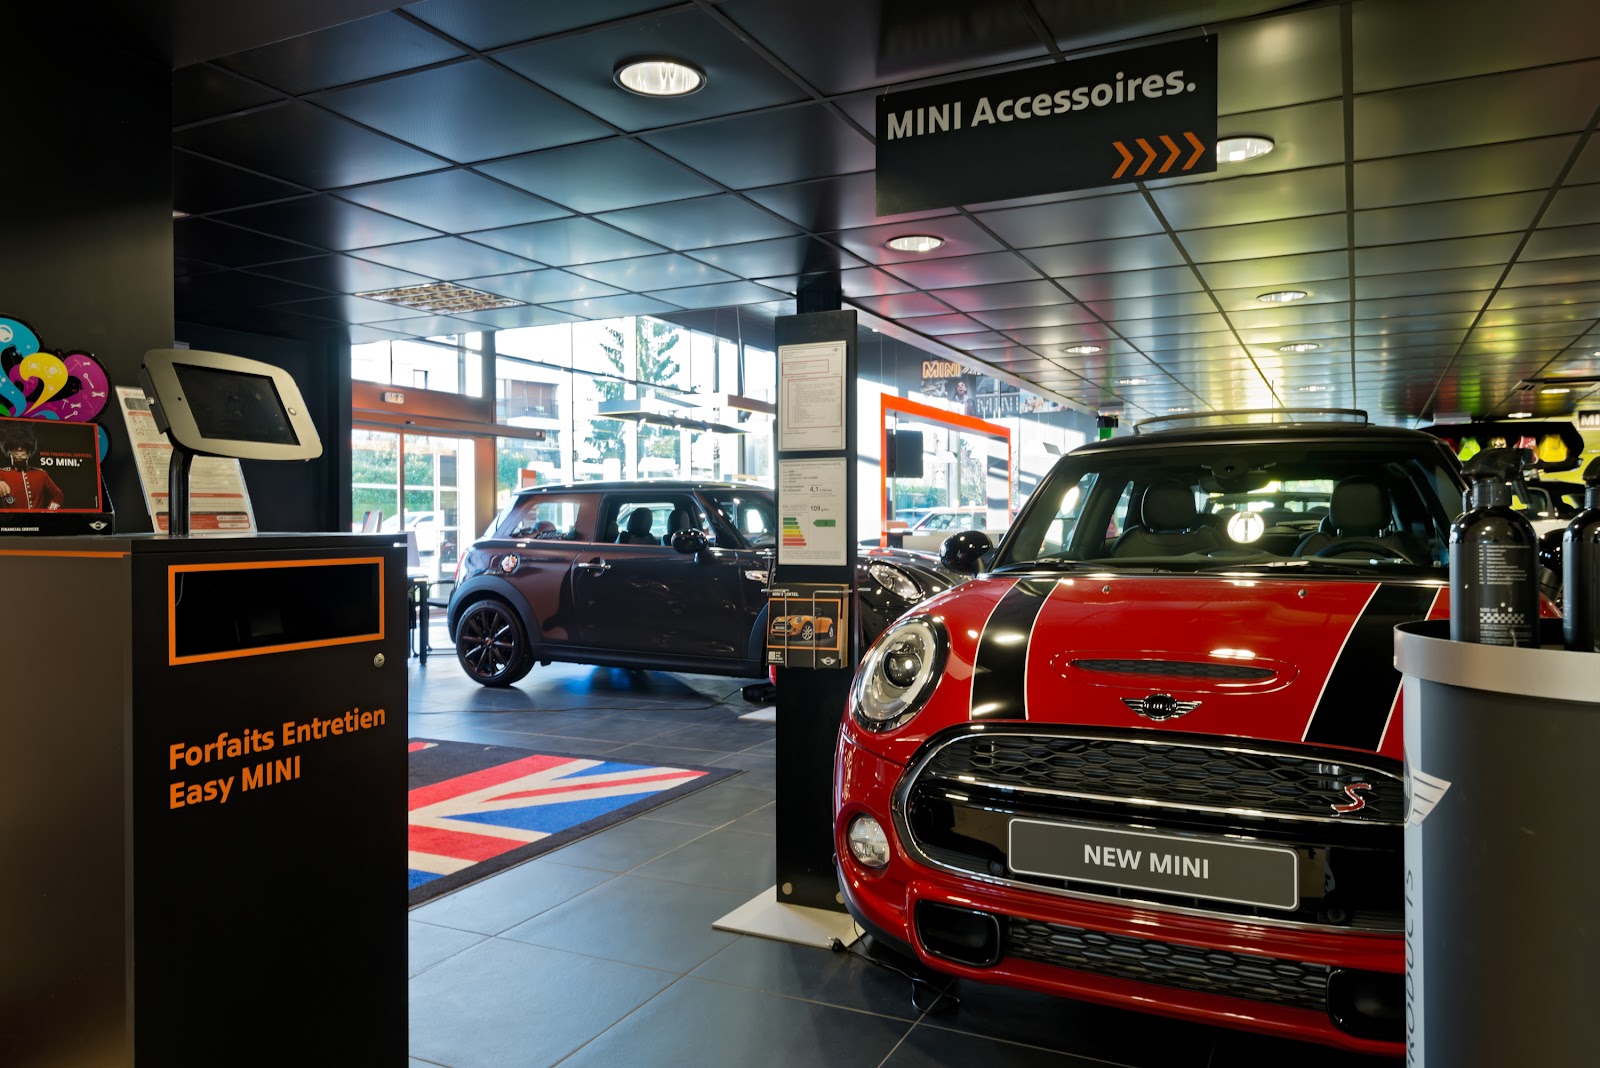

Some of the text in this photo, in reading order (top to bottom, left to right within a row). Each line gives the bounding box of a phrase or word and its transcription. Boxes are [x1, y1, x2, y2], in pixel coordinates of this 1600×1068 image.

[886, 70, 1196, 141] MINI Accessoires.
[922, 360, 961, 379] MINI
[977, 396, 1019, 413] MINI
[40, 457, 52, 466] SO
[169, 707, 386, 771] Forfaits Entretien
[169, 755, 301, 810] Easy MINI
[1331, 782, 1372, 813] S
[1084, 844, 1209, 879] NEW MINI
